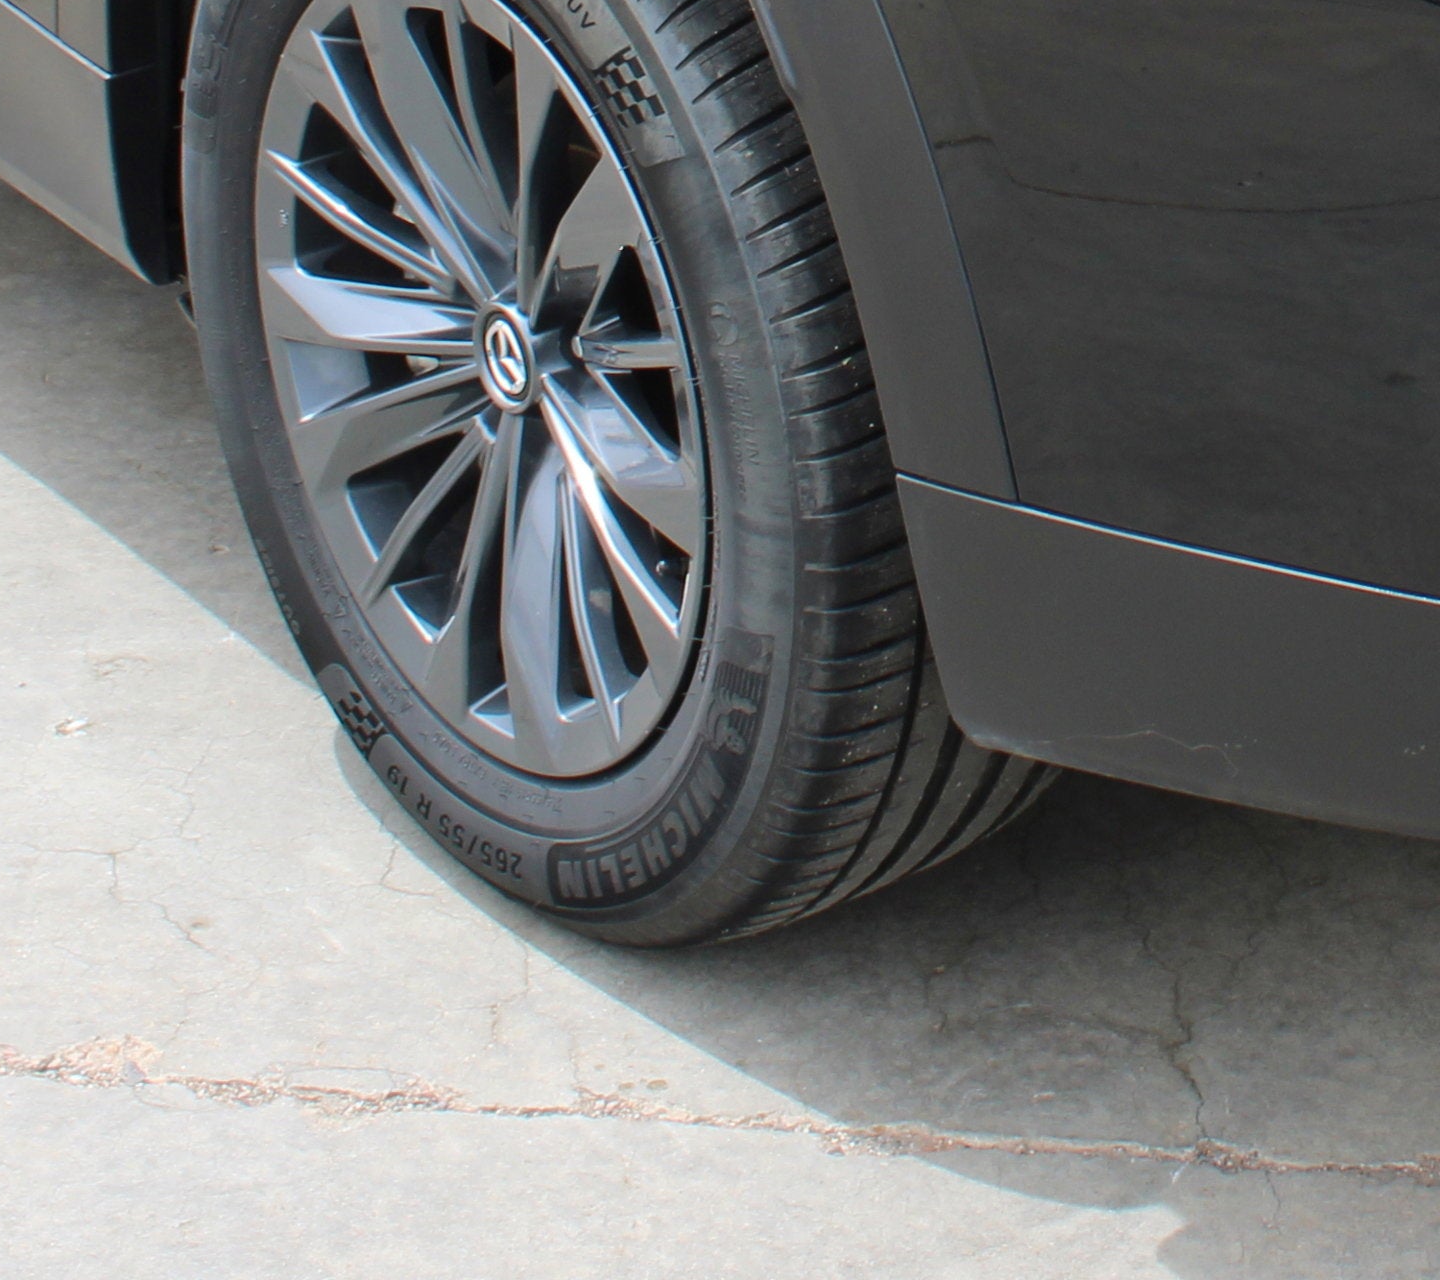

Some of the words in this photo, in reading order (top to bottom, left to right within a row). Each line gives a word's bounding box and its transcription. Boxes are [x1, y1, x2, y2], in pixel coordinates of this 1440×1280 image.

[386, 764, 410, 795] 19
[415, 792, 434, 819] R
[437, 814, 522, 880] 265/55
[559, 762, 727, 900] MICHELIN
